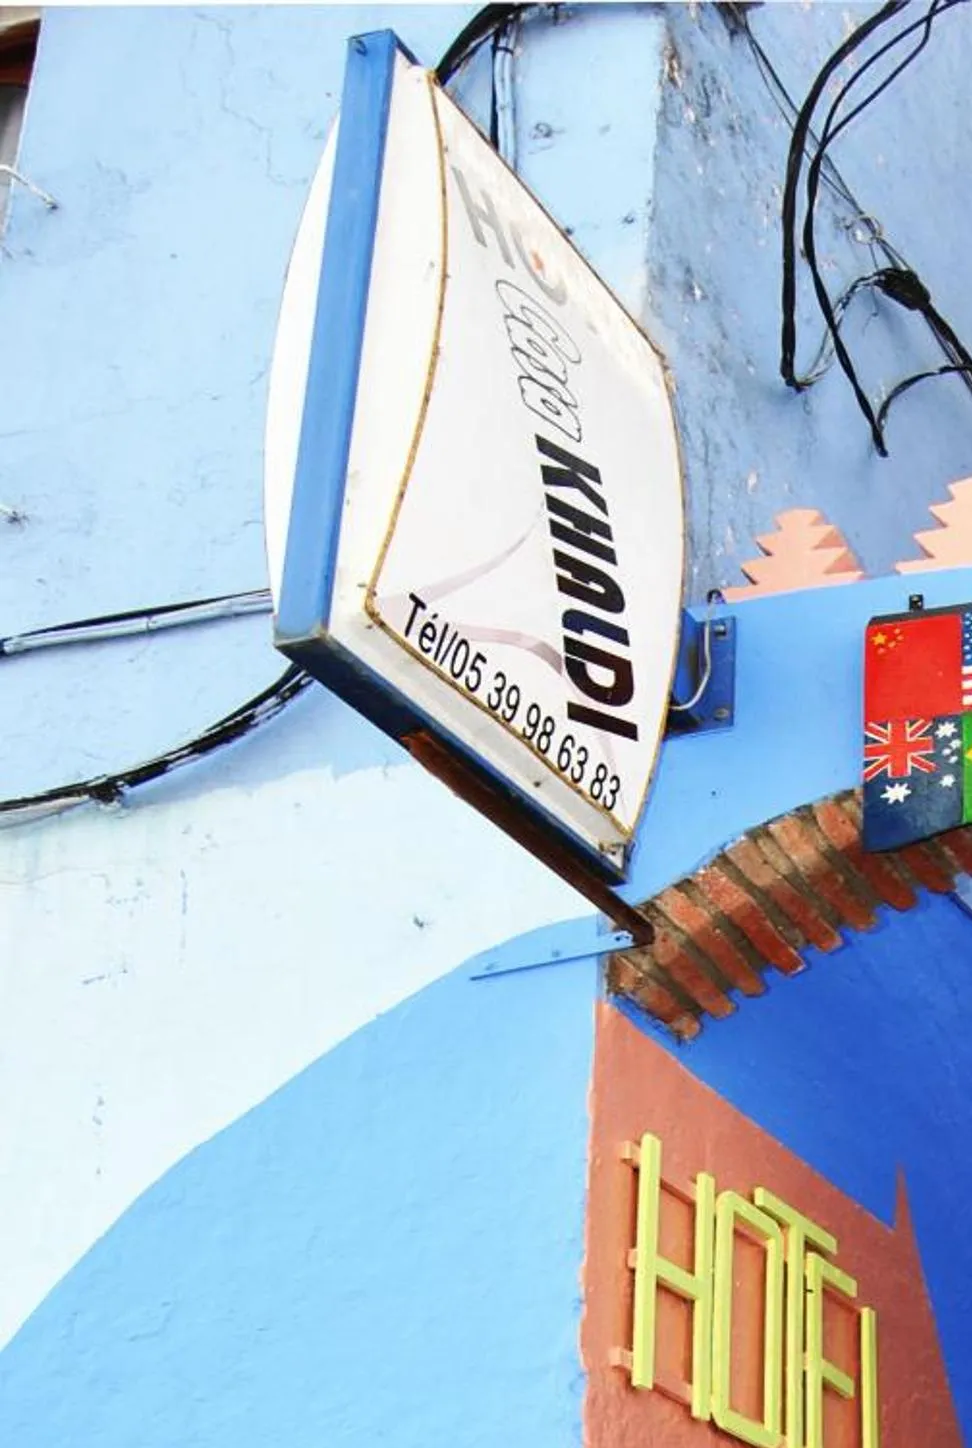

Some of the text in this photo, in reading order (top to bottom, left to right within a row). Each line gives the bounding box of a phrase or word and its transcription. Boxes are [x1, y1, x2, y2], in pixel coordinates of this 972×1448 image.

[534, 432, 639, 743] KHALDI
[487, 671, 521, 724] 39
[521, 702, 556, 755] 98
[556, 734, 589, 784] 63
[589, 762, 621, 812] 83
